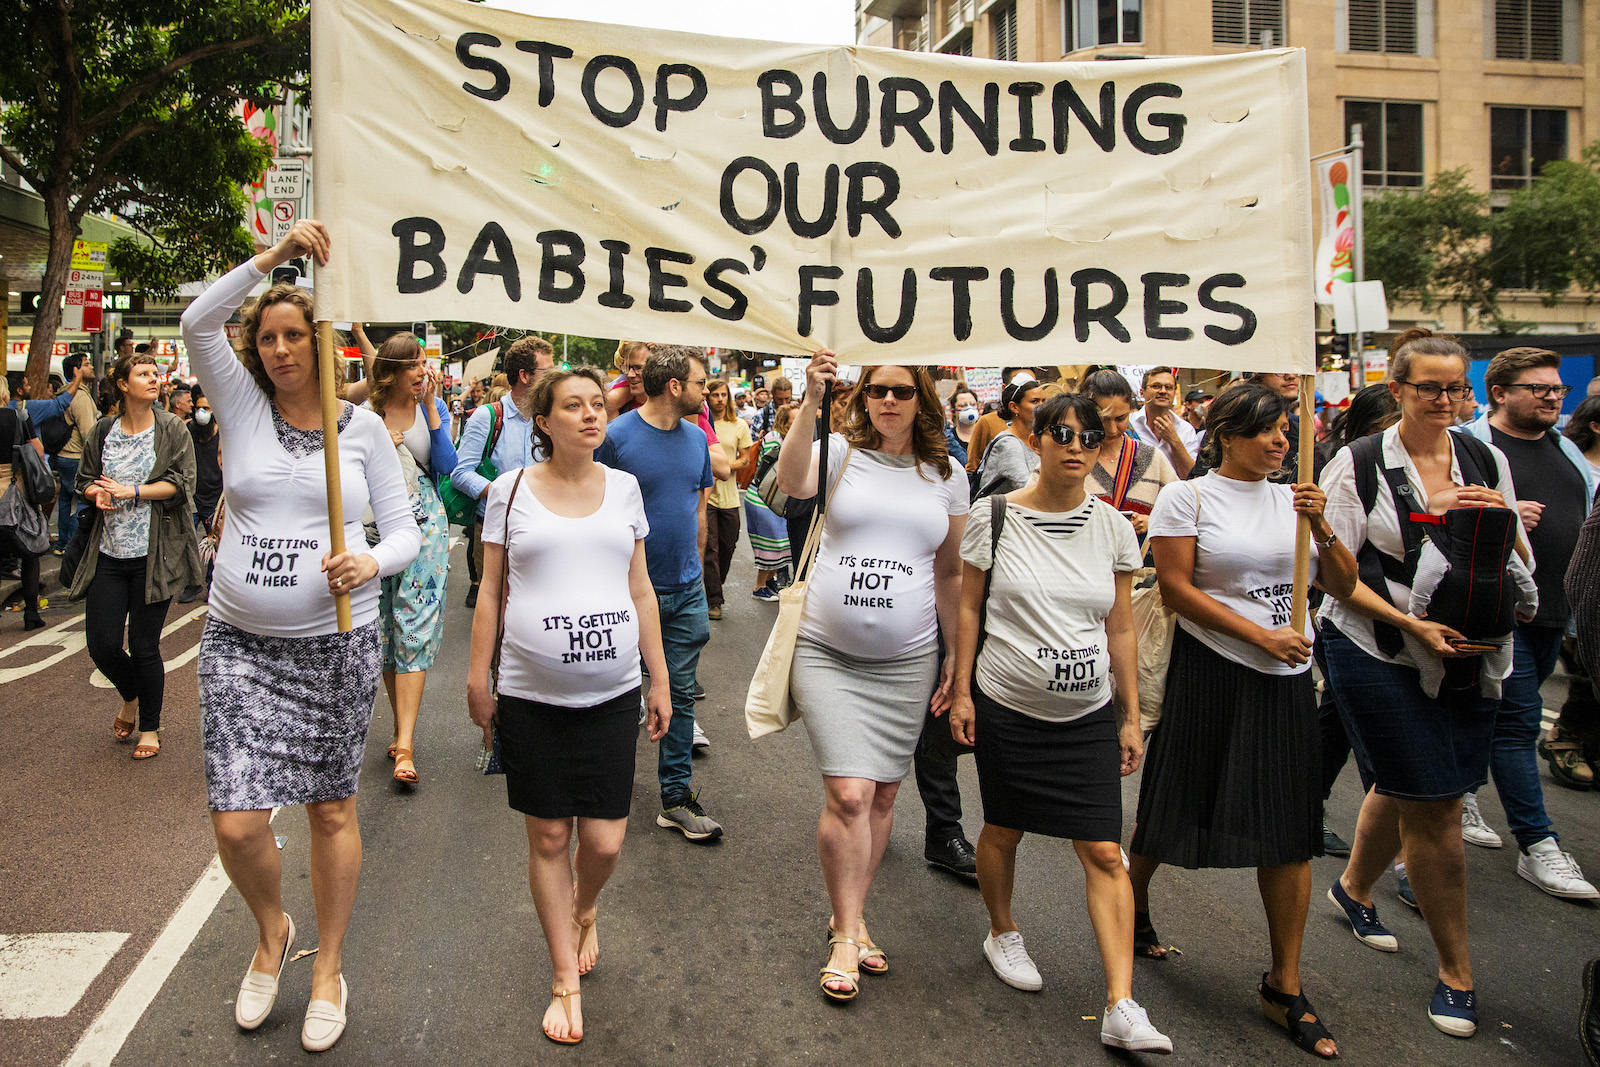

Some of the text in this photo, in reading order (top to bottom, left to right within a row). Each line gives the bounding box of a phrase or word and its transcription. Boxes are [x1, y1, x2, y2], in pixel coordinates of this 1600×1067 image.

[455, 32, 1188, 156] STOP BURNING
[270, 175, 299, 183] LANE
[274, 186, 295, 194] END
[719, 156, 902, 239] OUR
[277, 223, 290, 231] NO
[81, 274, 102, 282] 24hrs
[392, 216, 1258, 346] BABIES' FUTURES
[90, 292, 99, 300] NO
[241, 533, 319, 550] IT'S GETTING
[251, 550, 299, 573] HOT
[838, 554, 914, 576] IT'S GETTING
[245, 571, 298, 587] IN HERE
[850, 571, 894, 590] HOT
[843, 594, 894, 609] IN HERE
[542, 610, 630, 631] IT'S GETTING
[1271, 613, 1287, 626] IN
[568, 628, 613, 651] HOT
[561, 647, 617, 664] IN HERE
[1036, 644, 1100, 660] IT'S GETTING
[1054, 659, 1096, 681] HOT
[1046, 677, 1100, 692] IN HERE
